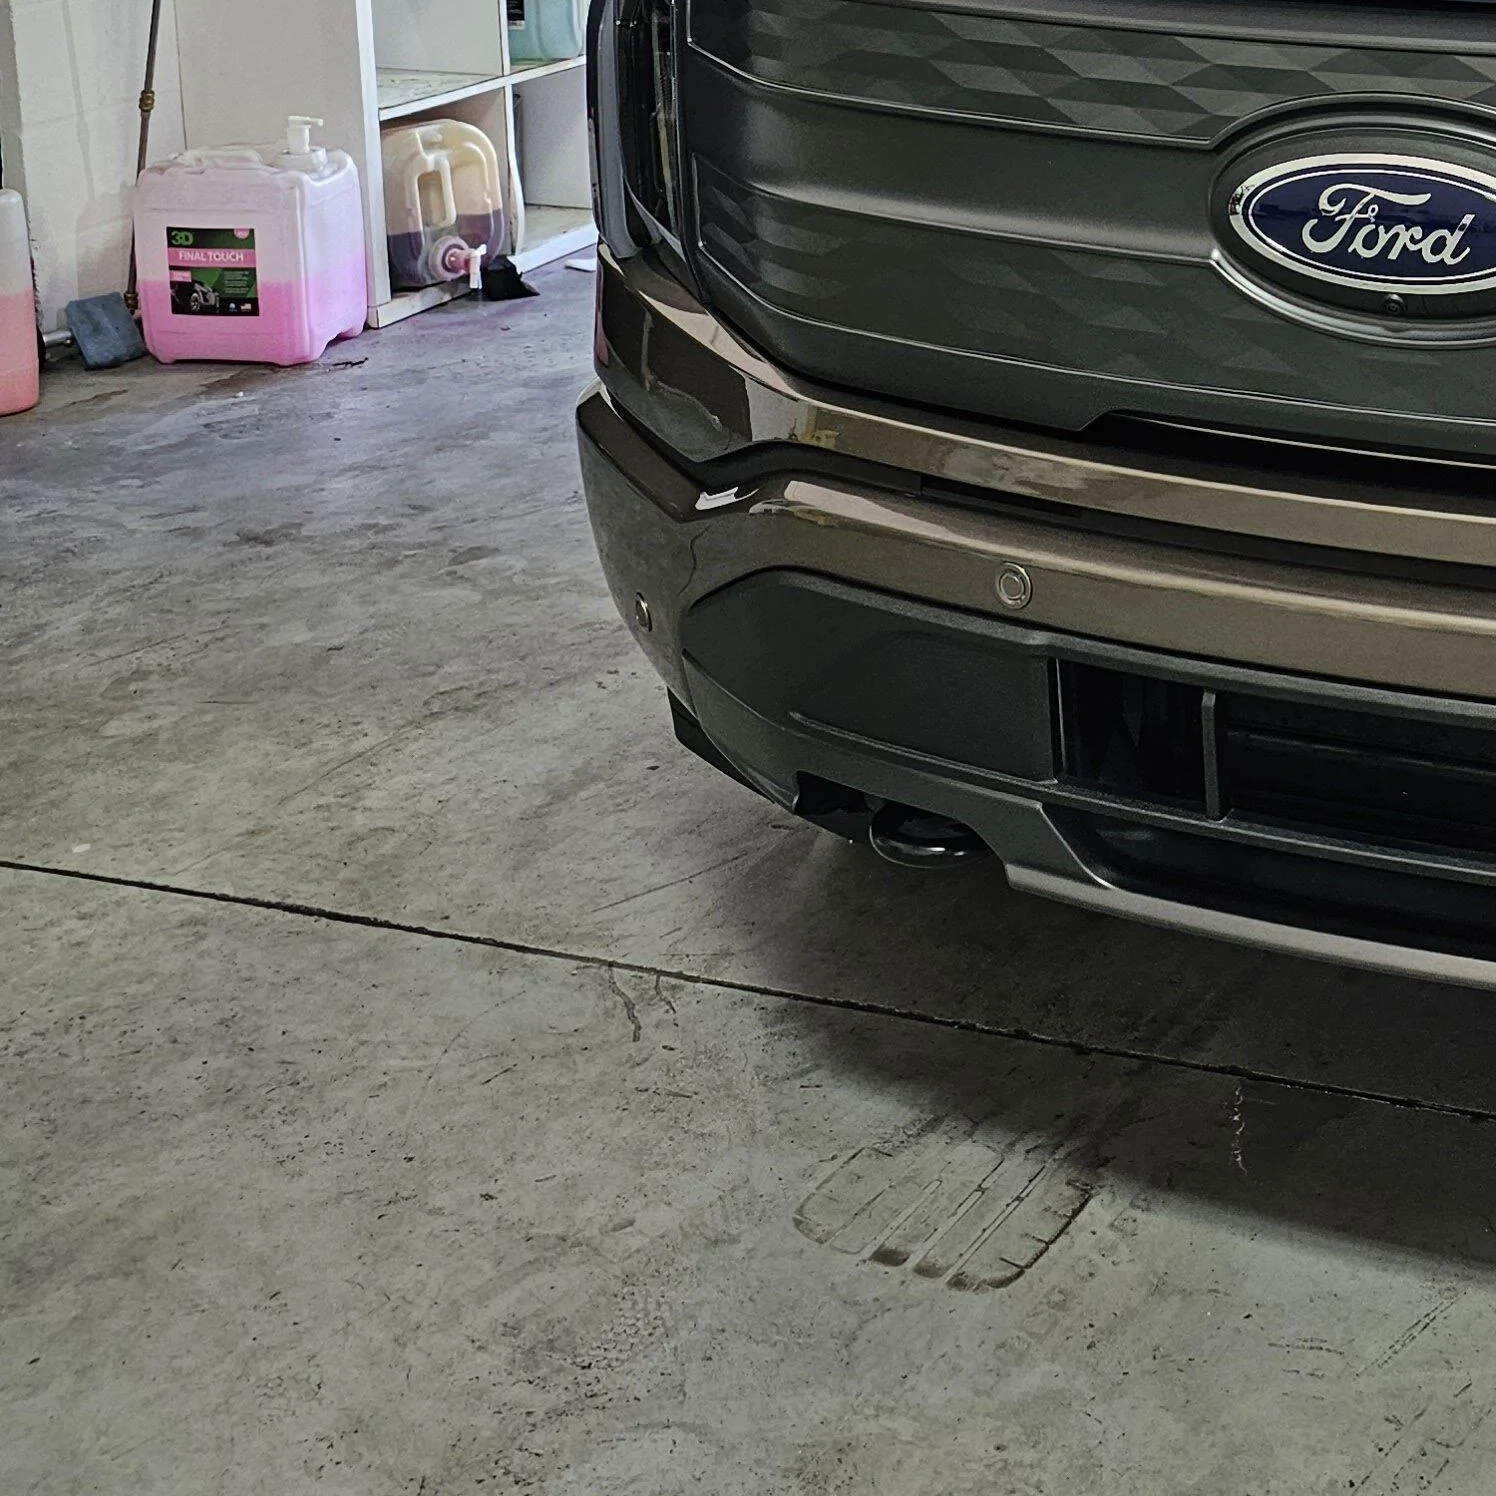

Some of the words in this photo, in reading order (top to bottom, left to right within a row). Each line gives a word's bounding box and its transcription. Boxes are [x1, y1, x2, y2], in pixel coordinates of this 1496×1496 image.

[1302, 183, 1475, 265] Ford
[170, 230, 194, 246] 3D
[179, 251, 206, 261] FINAL
[207, 251, 244, 262] TOUCH
